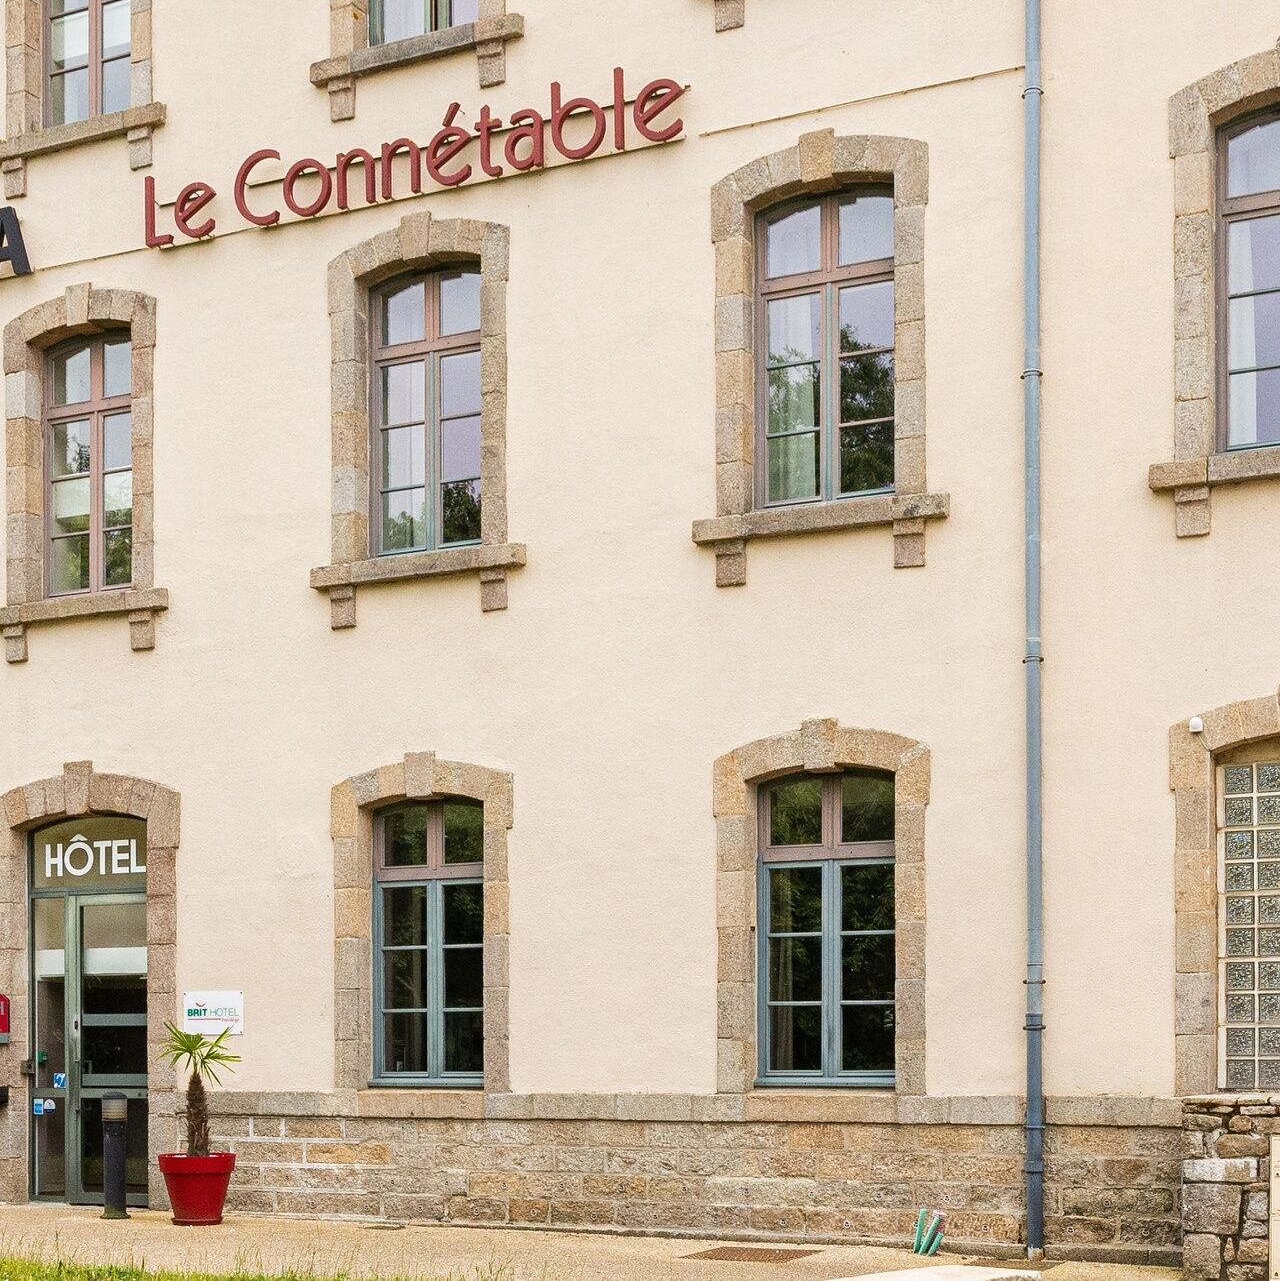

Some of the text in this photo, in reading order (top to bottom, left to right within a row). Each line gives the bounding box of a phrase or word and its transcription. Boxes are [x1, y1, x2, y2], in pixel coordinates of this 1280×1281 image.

[144, 66, 685, 249] Le Connétable
[45, 833, 147, 878] HÔTEL
[187, 1007, 239, 1017] BRIT HOTEL
